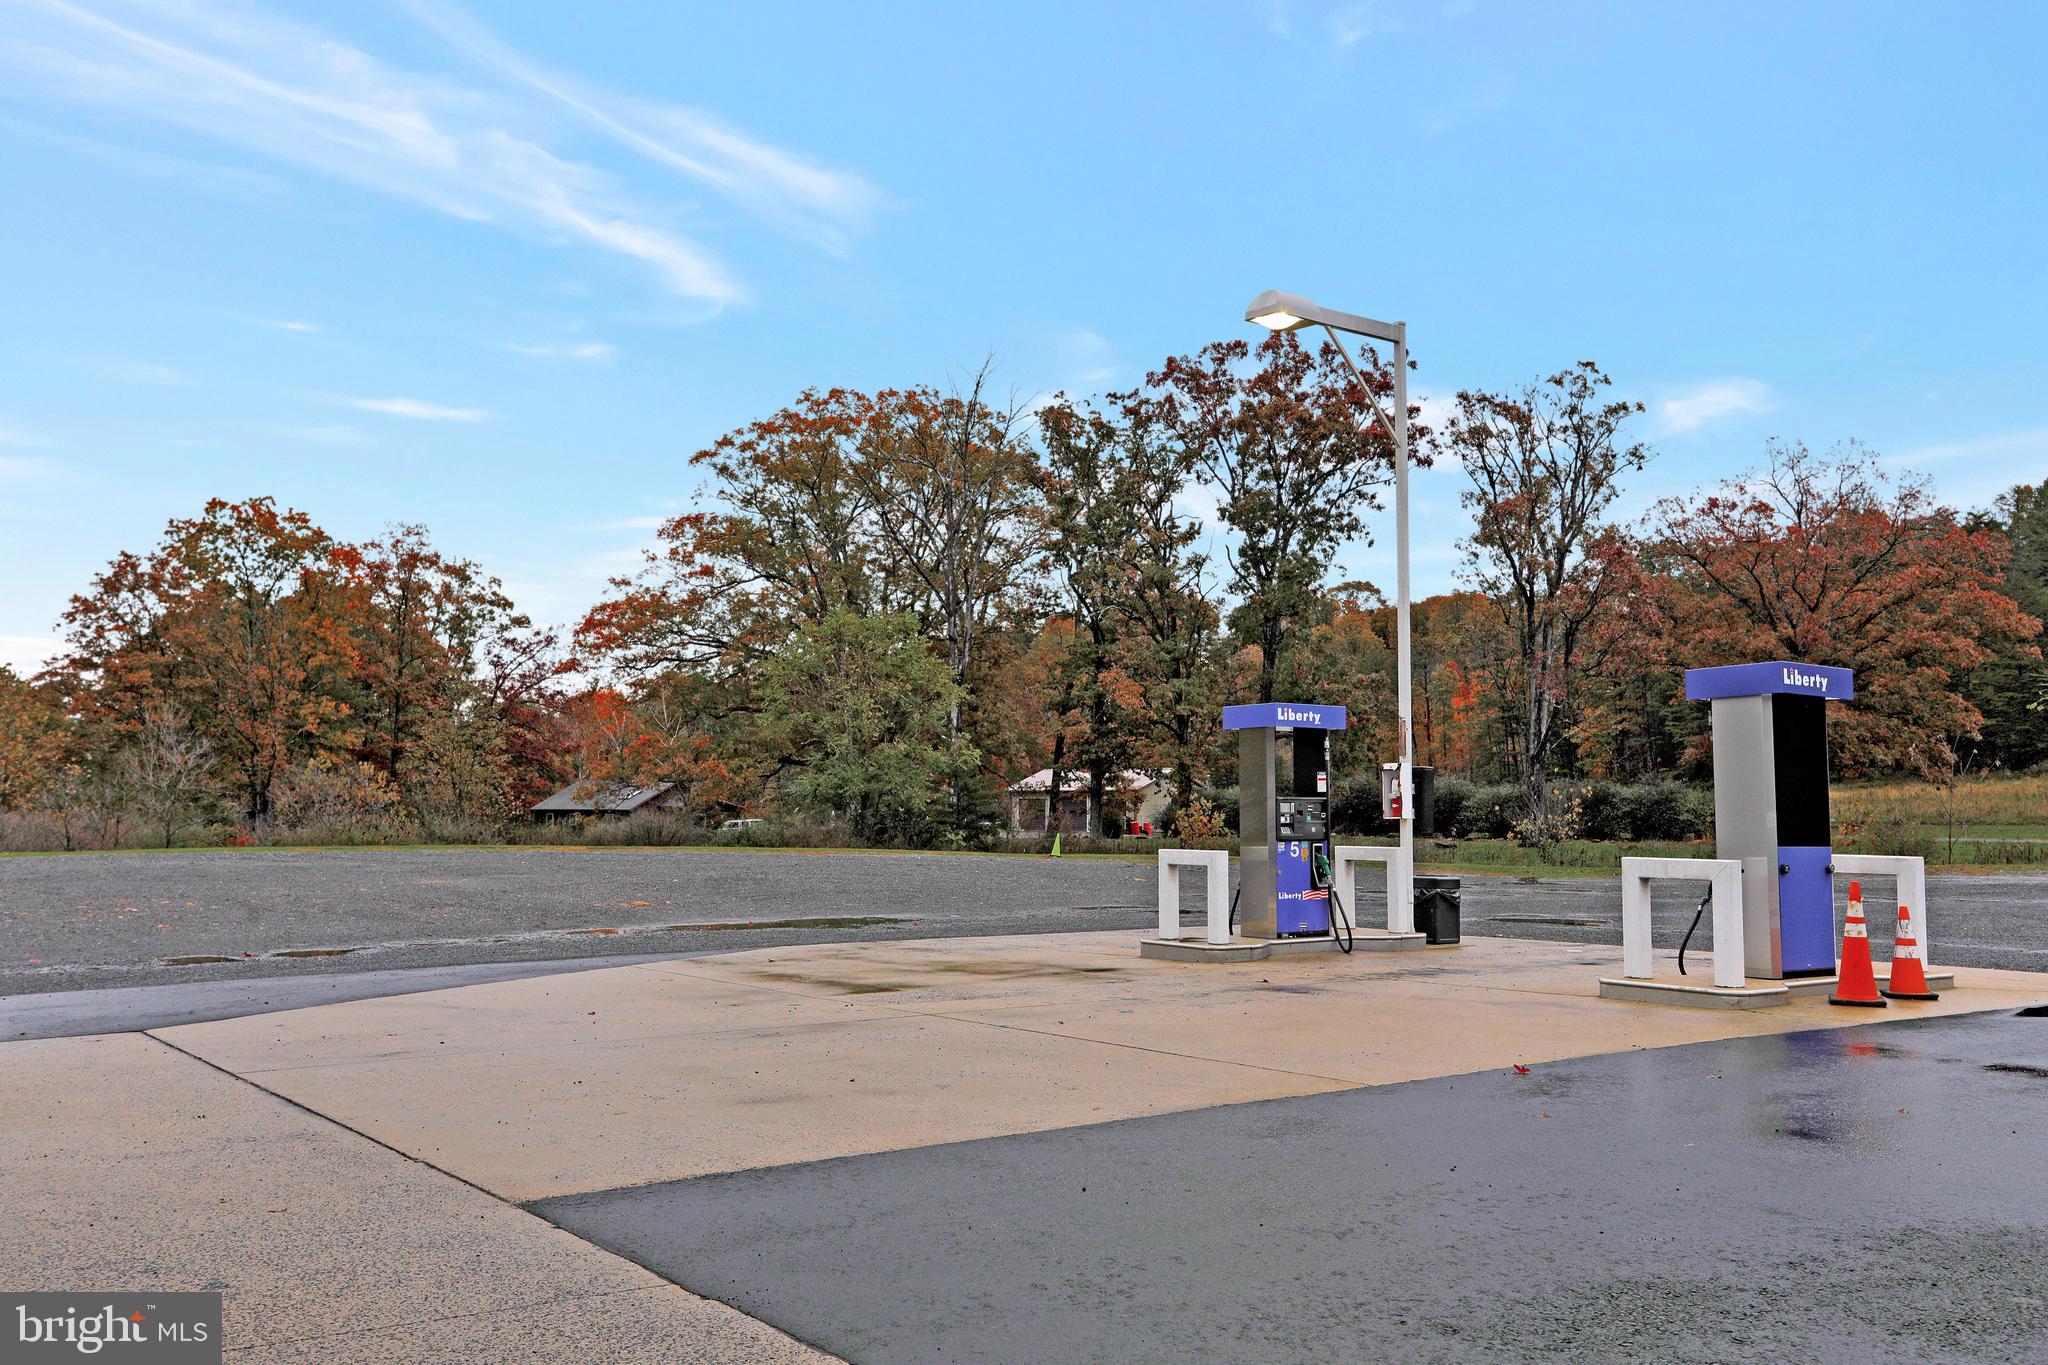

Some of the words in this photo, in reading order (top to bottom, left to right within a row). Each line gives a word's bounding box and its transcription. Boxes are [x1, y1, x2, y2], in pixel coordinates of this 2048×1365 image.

[1782, 666, 1828, 692] Liberty
[1277, 706, 1321, 725] Liberty
[1290, 841, 1300, 857] 5
[1278, 891, 1302, 900] Liberty
